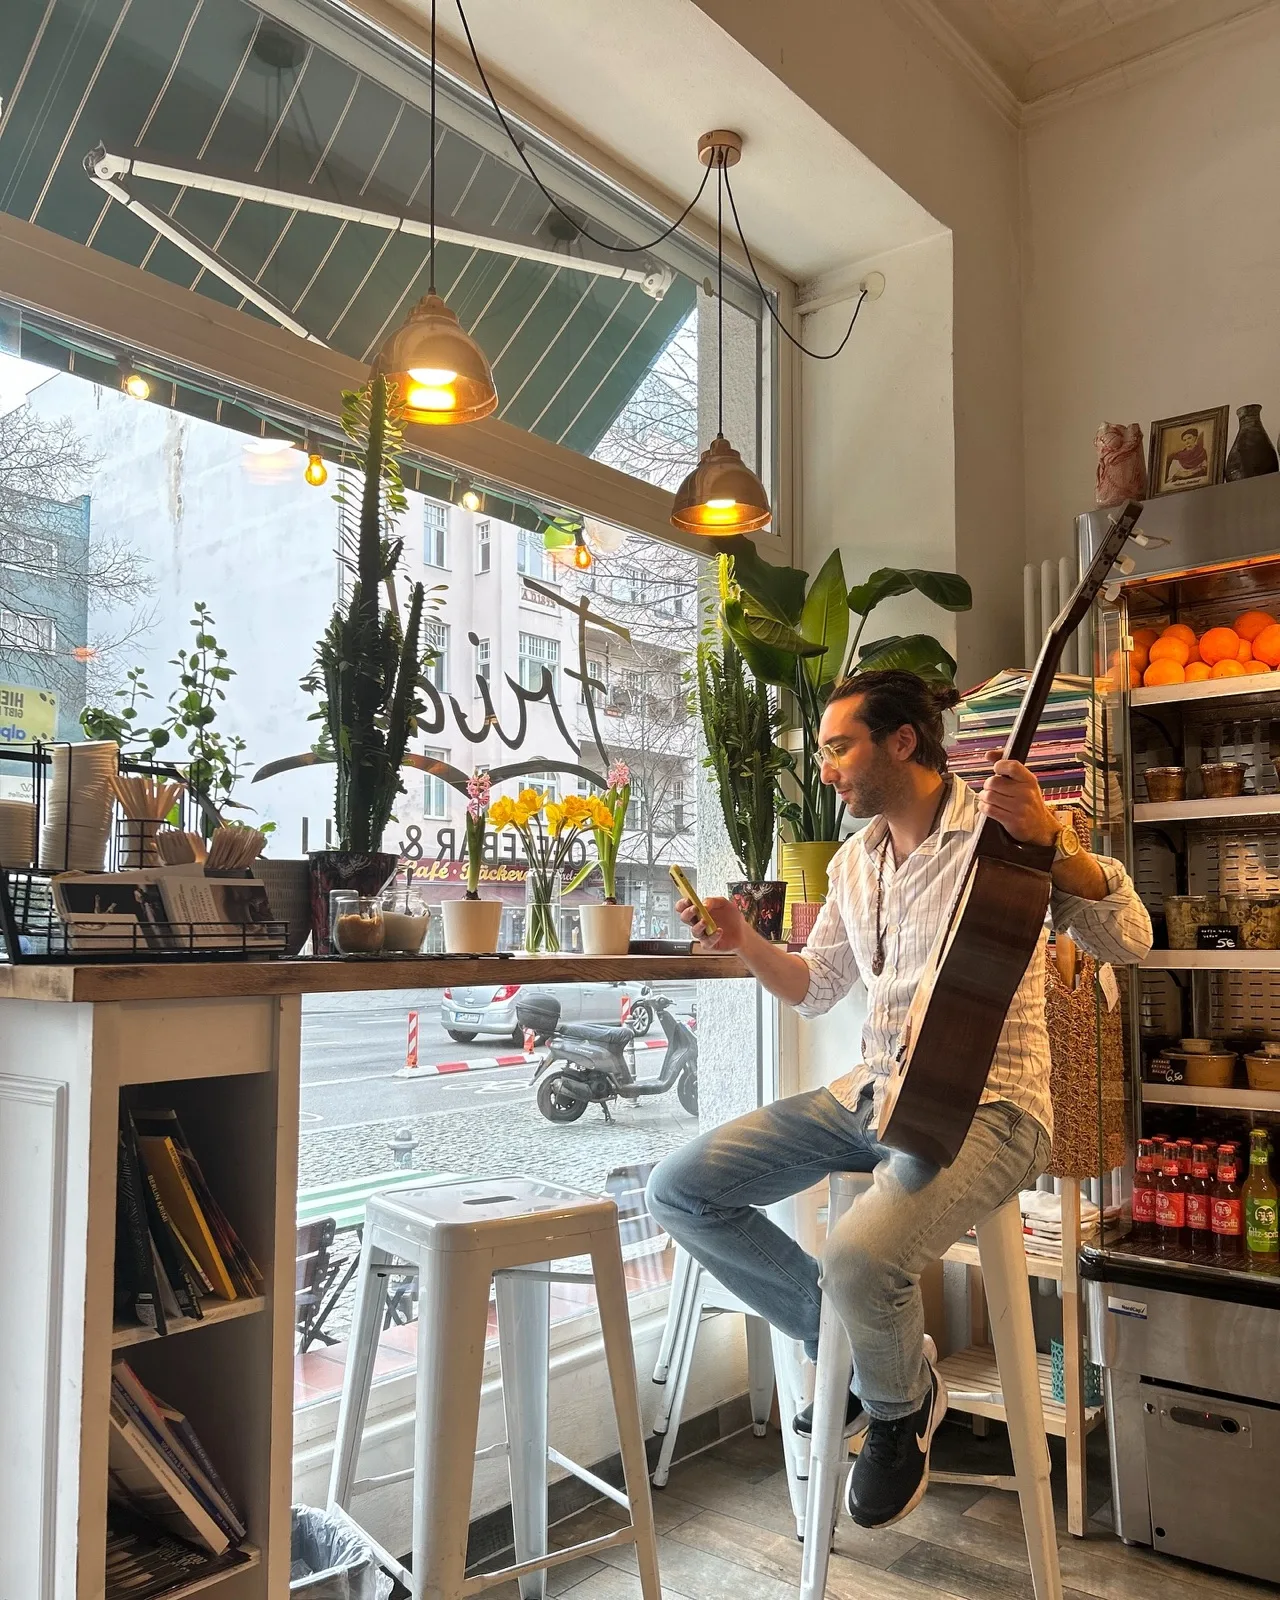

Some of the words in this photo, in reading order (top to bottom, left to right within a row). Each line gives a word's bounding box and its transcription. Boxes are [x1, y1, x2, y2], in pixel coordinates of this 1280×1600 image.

[402, 860, 450, 881] Café
[1215, 938, 1236, 949] 5€
[147, 1174, 161, 1201] BERLIN
[157, 1200, 169, 1223] KRIMI
